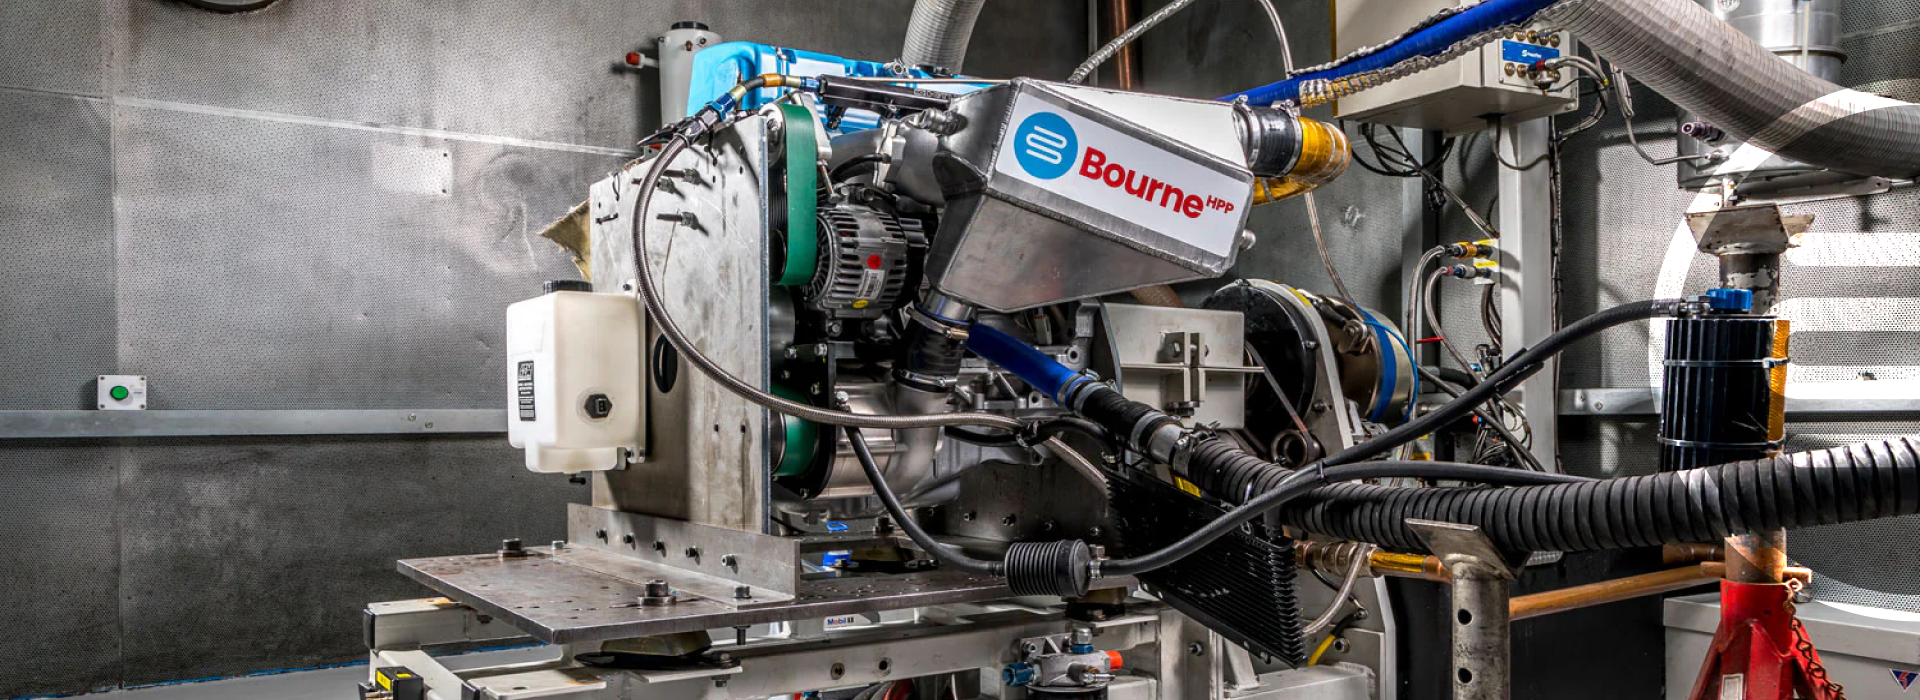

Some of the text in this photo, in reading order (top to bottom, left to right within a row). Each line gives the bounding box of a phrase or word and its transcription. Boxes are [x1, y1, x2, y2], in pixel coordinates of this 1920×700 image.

[1079, 146, 1234, 218] Bourne HPP
[827, 617, 847, 625] Mobil
